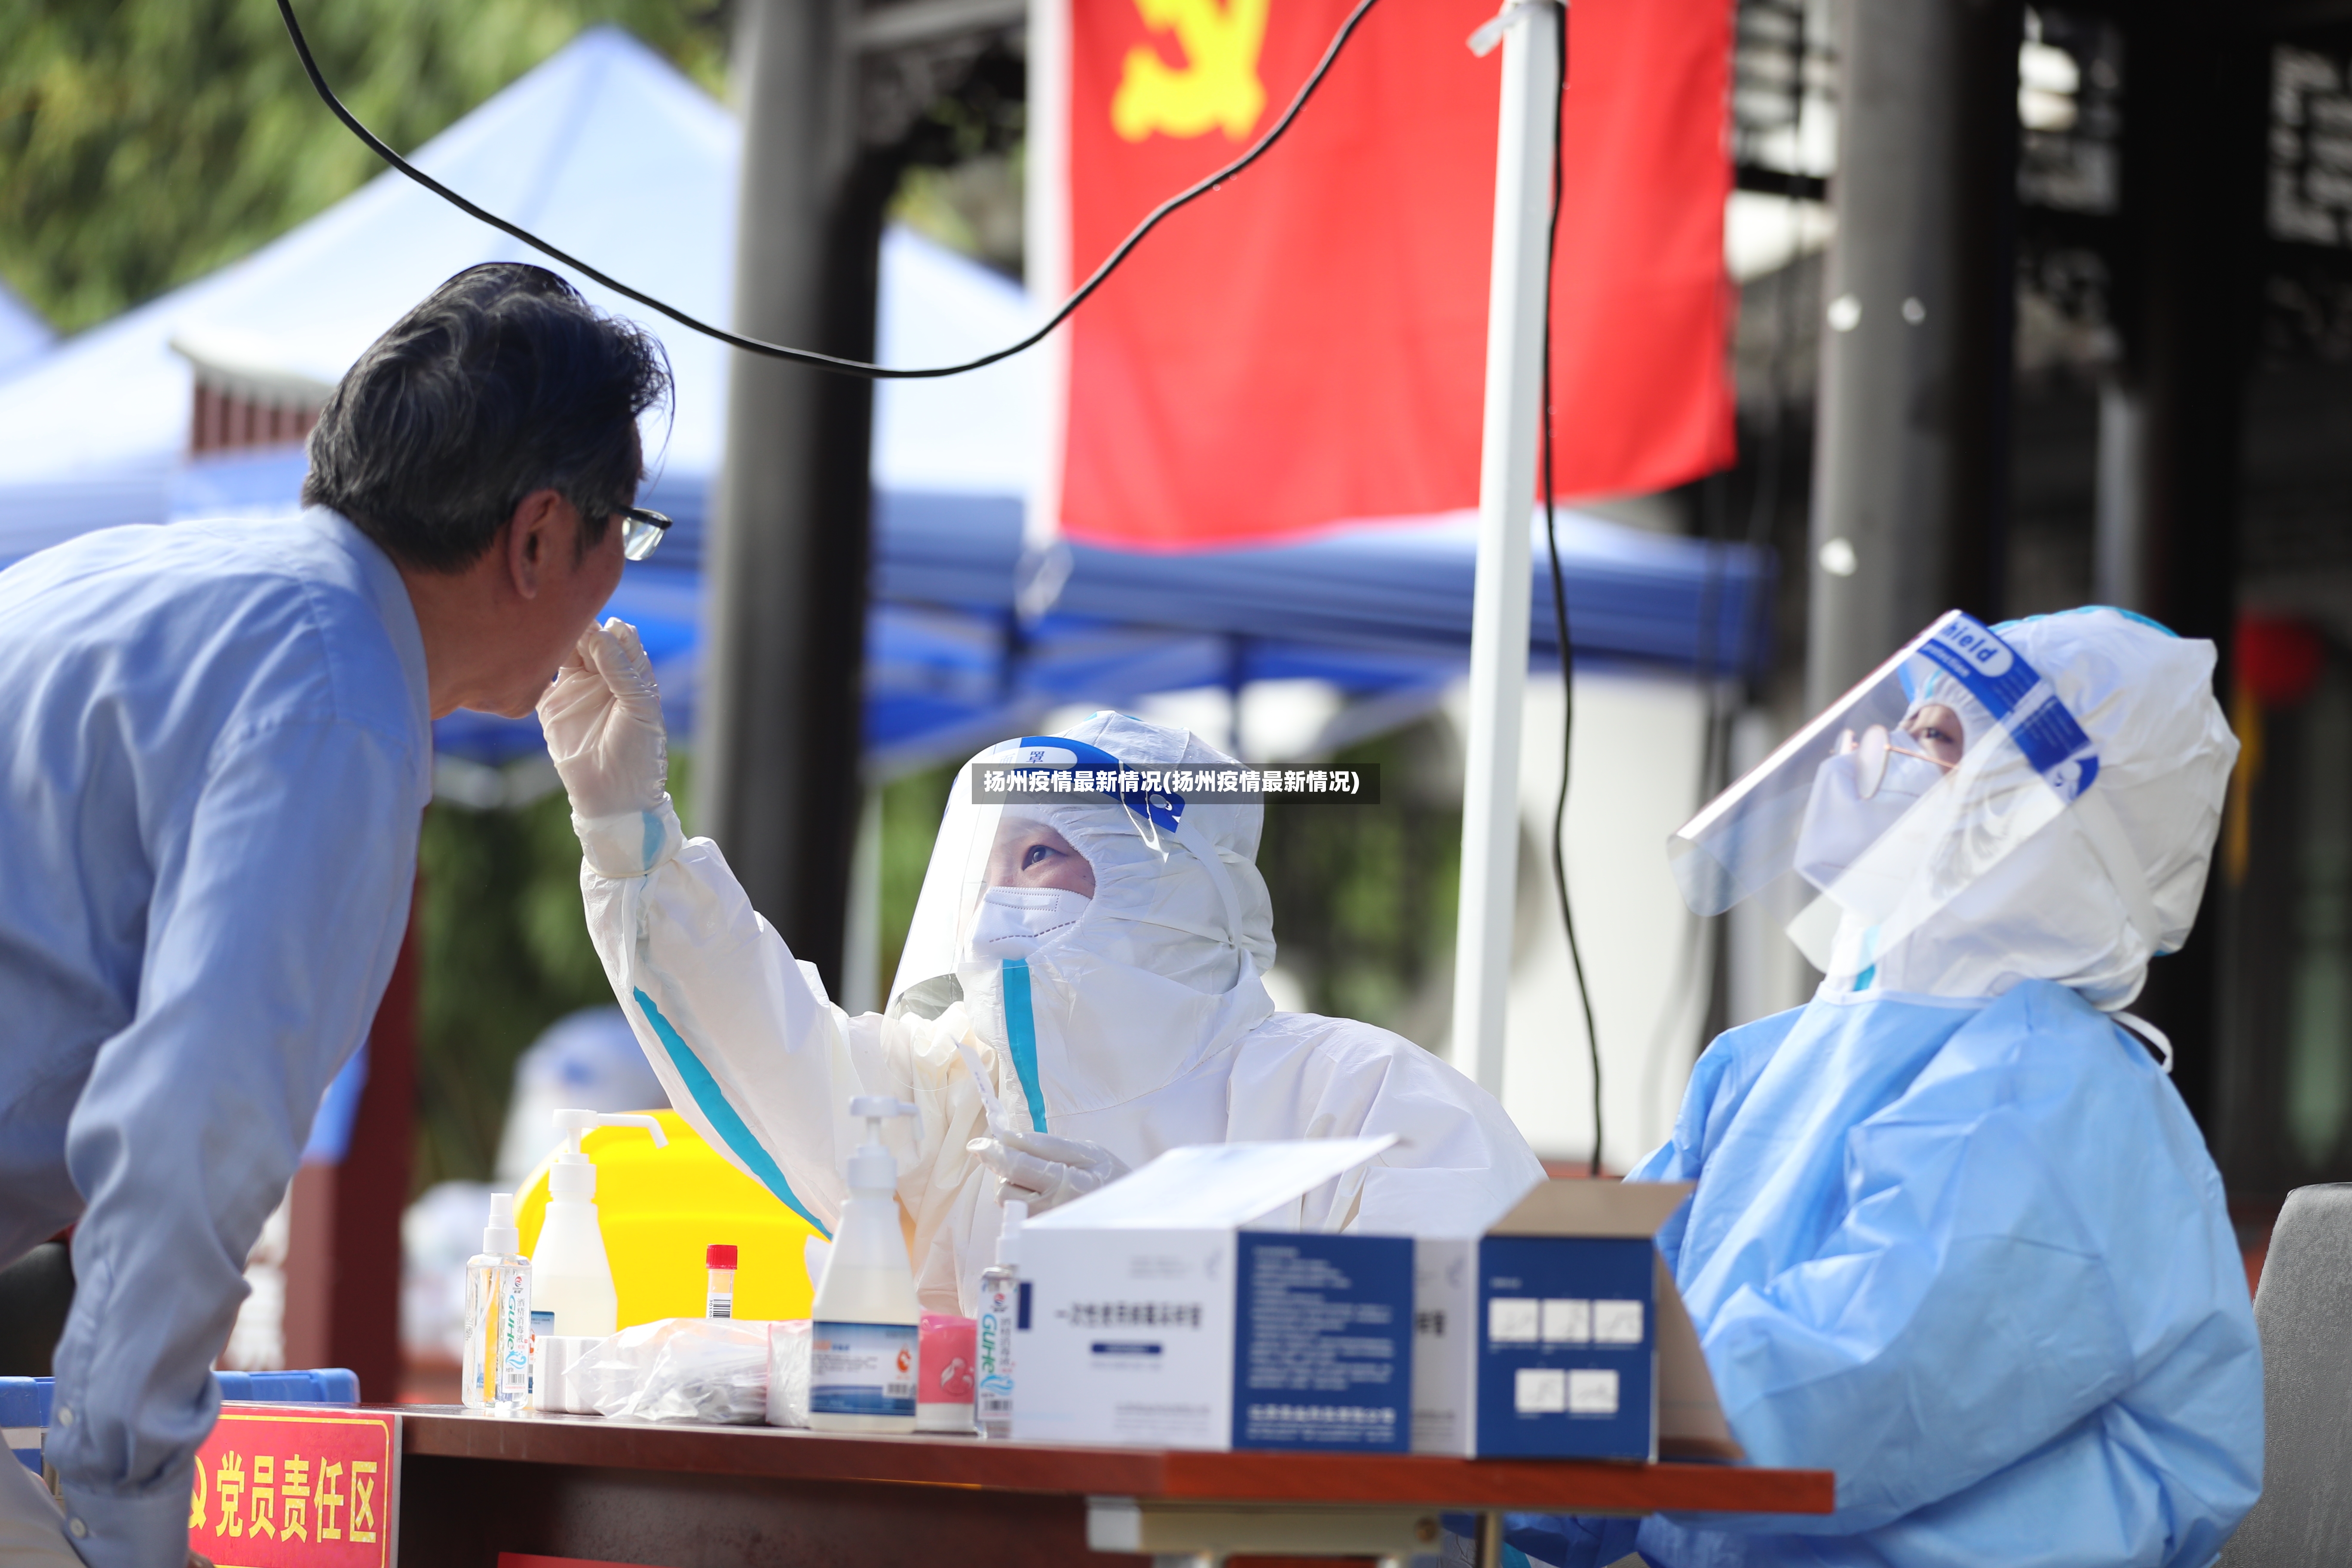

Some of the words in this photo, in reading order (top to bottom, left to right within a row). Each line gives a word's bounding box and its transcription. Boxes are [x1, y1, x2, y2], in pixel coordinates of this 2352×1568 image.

[516, 1298, 525, 1343] 酒精消毒液
[215, 1450, 378, 1544] 党员责任区
